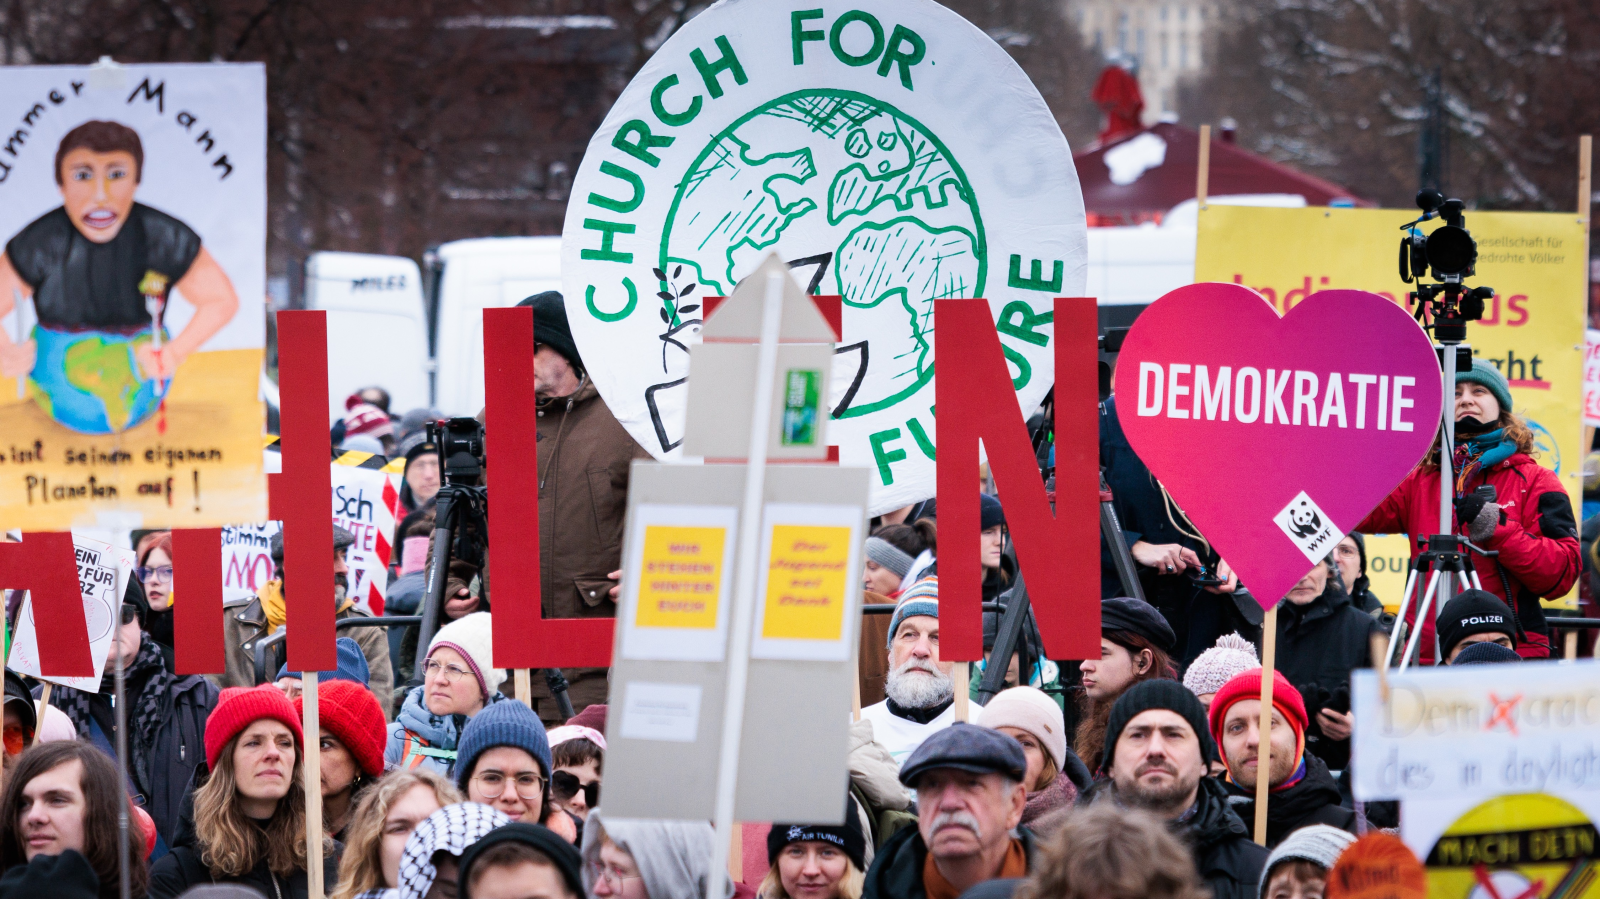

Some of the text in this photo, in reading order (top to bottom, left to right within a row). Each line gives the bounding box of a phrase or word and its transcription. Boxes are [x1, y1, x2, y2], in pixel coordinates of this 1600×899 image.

[790, 8, 926, 91] FOR
[127, 78, 234, 181] Mann
[581, 34, 748, 322] CHURCH
[1528, 252, 1566, 265] Völker
[1546, 236, 1564, 248] für
[868, 254, 1064, 487] FUURE
[1136, 361, 1416, 432] DEMOKRATIE
[25, 474, 118, 504] Planeten
[137, 477, 175, 507] auf
[1306, 526, 1332, 552] WWF
[84, 567, 113, 586] FÜR
[1460, 615, 1504, 627] POLIZEI
[801, 832, 815, 841] AIR
[1437, 828, 1595, 866] MACH DEIN
